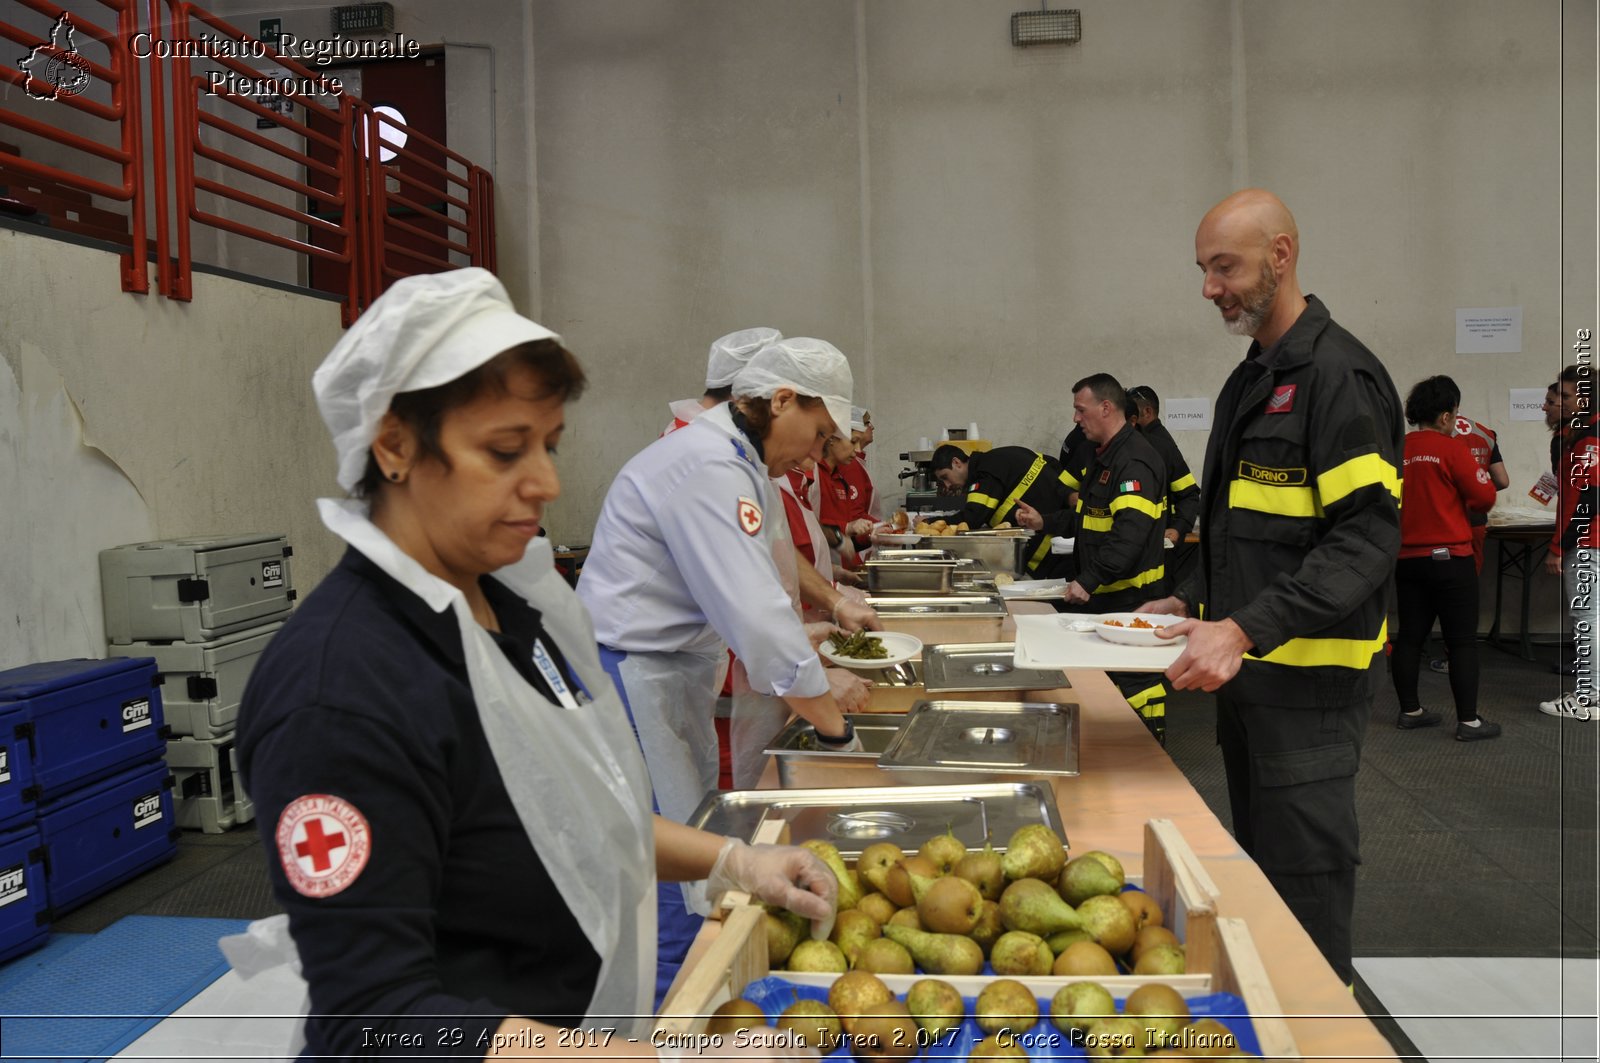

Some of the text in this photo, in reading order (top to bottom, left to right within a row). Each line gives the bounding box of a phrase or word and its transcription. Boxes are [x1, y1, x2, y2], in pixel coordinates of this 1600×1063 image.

[1250, 467, 1289, 482] TORINO
[263, 565, 281, 577] Gmi
[122, 701, 149, 720] Gmi
[134, 796, 160, 817] Gmi
[0, 868, 24, 893] mi
